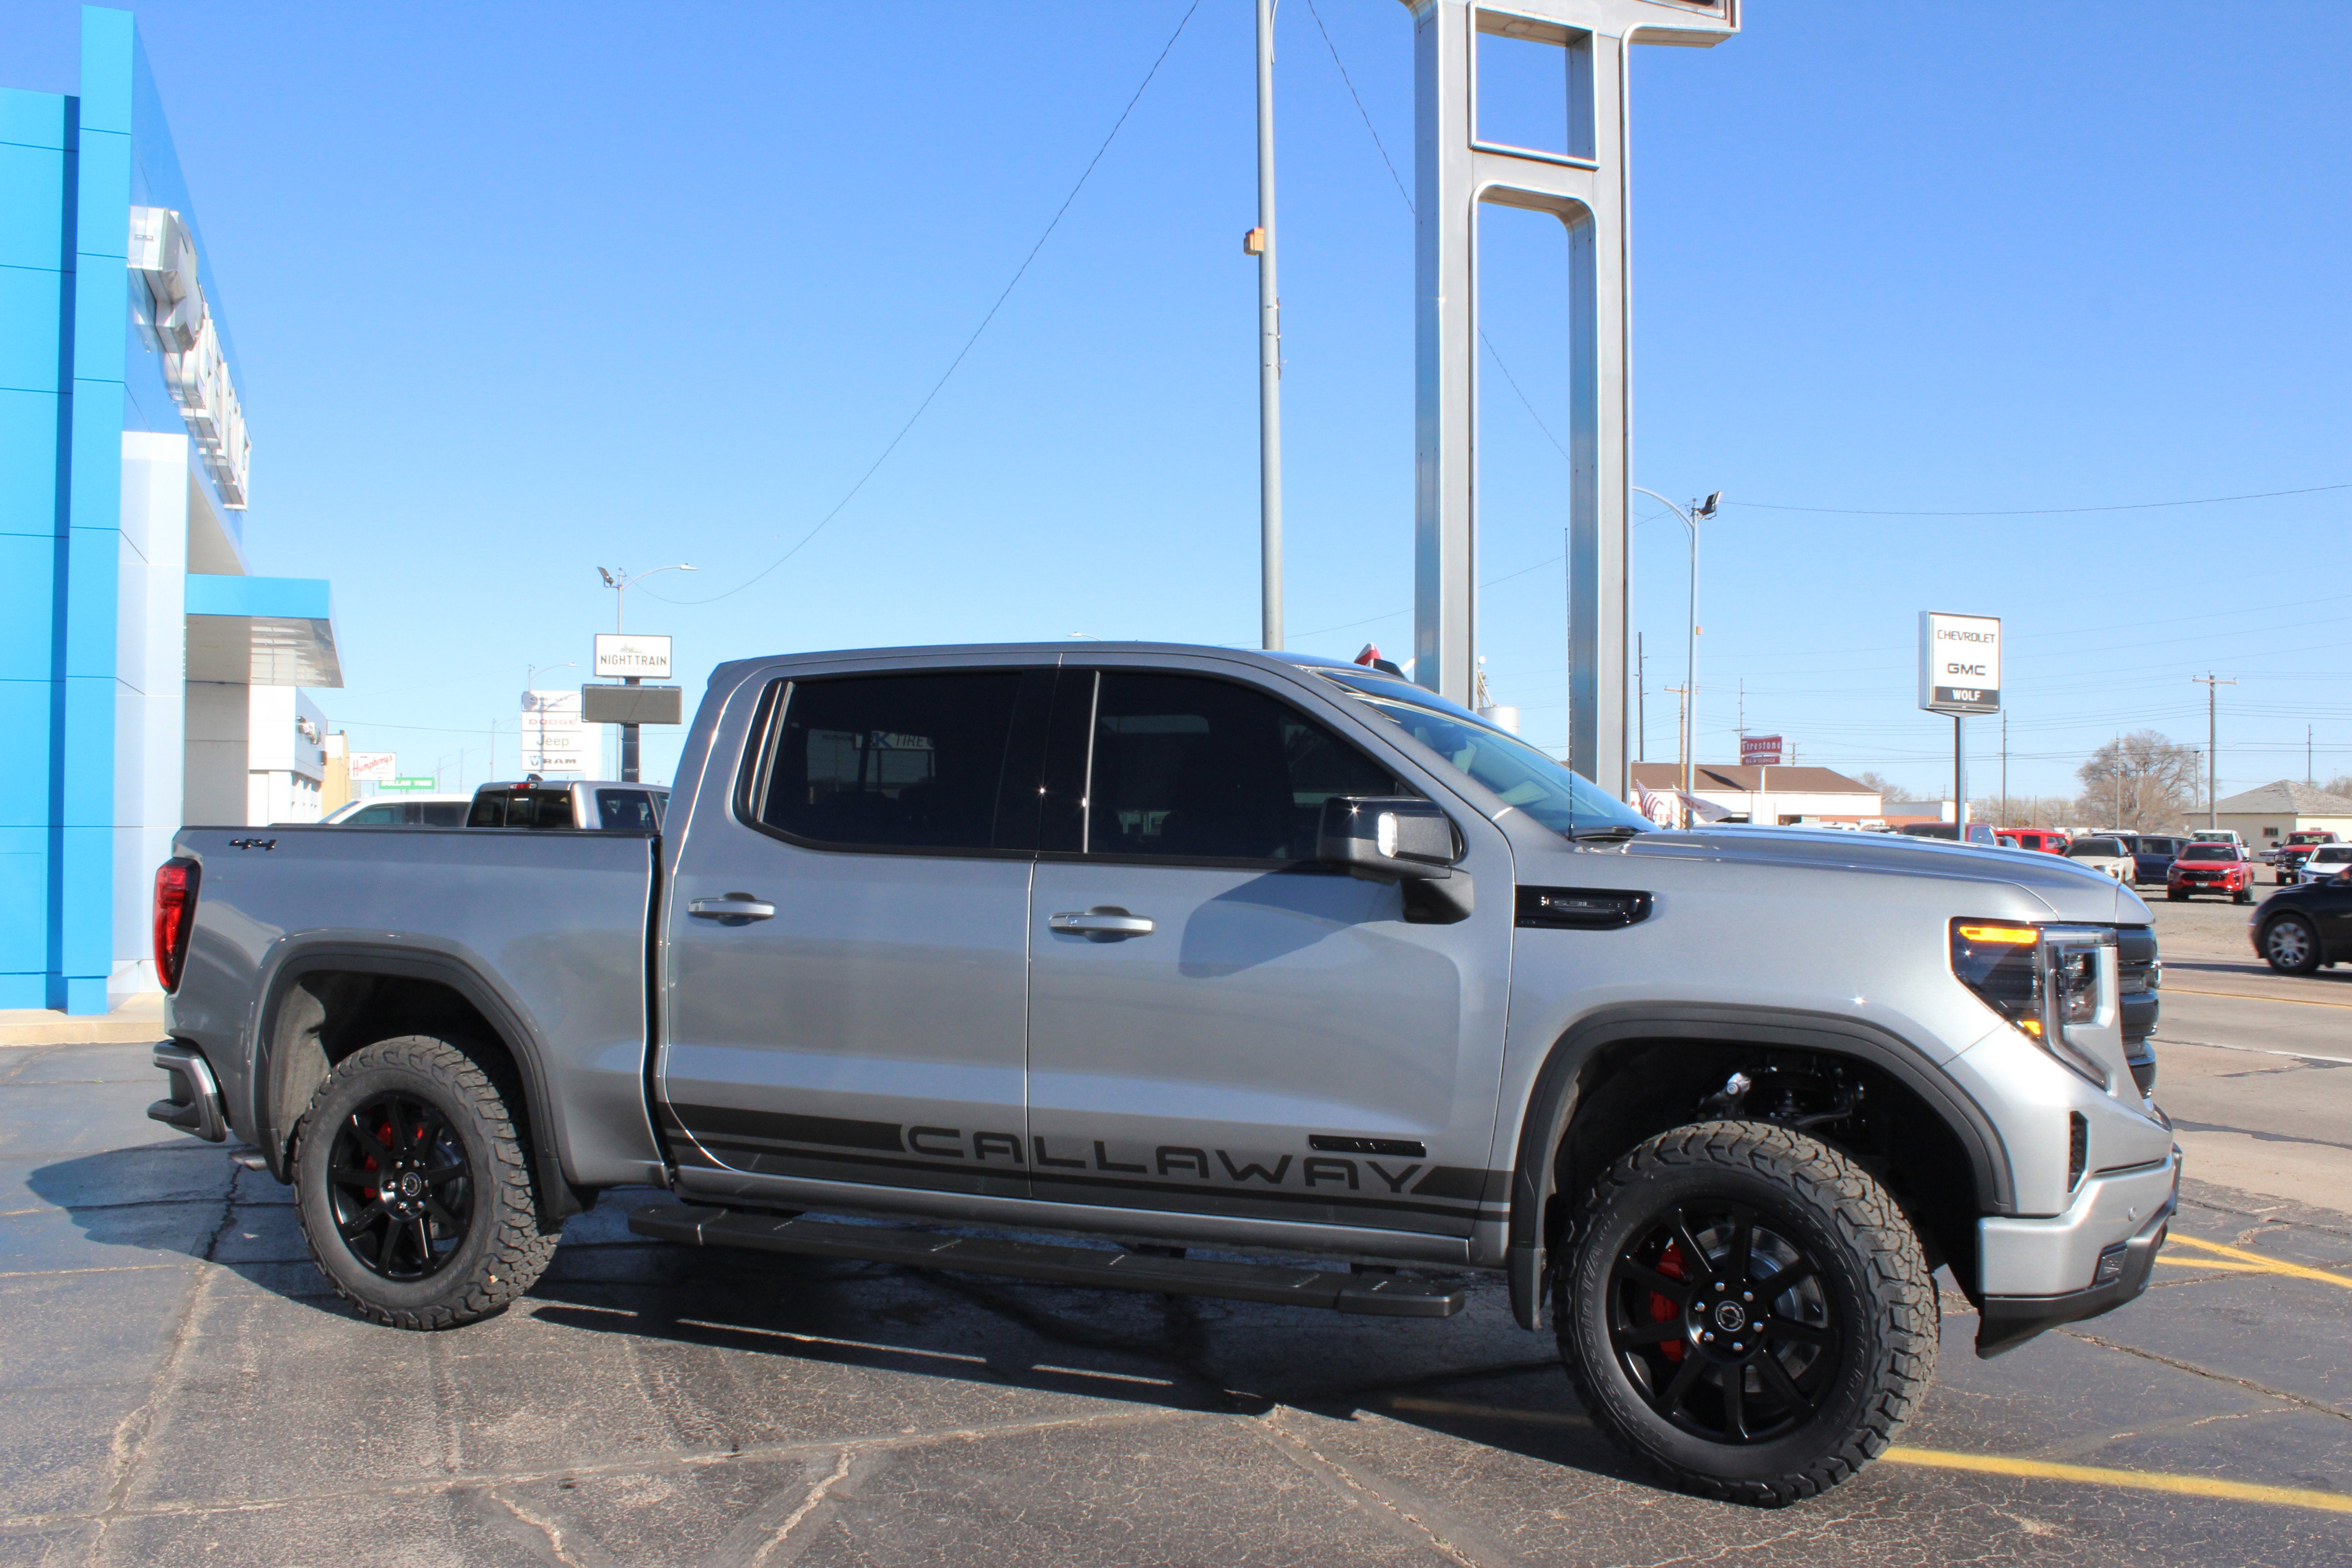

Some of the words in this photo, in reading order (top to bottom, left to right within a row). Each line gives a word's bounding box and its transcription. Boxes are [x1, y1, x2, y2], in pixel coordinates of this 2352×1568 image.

[1938, 630, 1995, 643] CHEVROLET
[601, 655, 634, 665] NIGHT
[635, 655, 667, 666] TRAIN
[1947, 663, 1986, 676] GMC
[1952, 689, 1981, 701] WOLF
[536, 734, 569, 748] Jeep
[896, 734, 925, 747] TIRE
[1741, 740, 1781, 751] Firestone
[353, 755, 392, 778] Humphreys
[908, 1126, 1422, 1193] CALLAWAY
